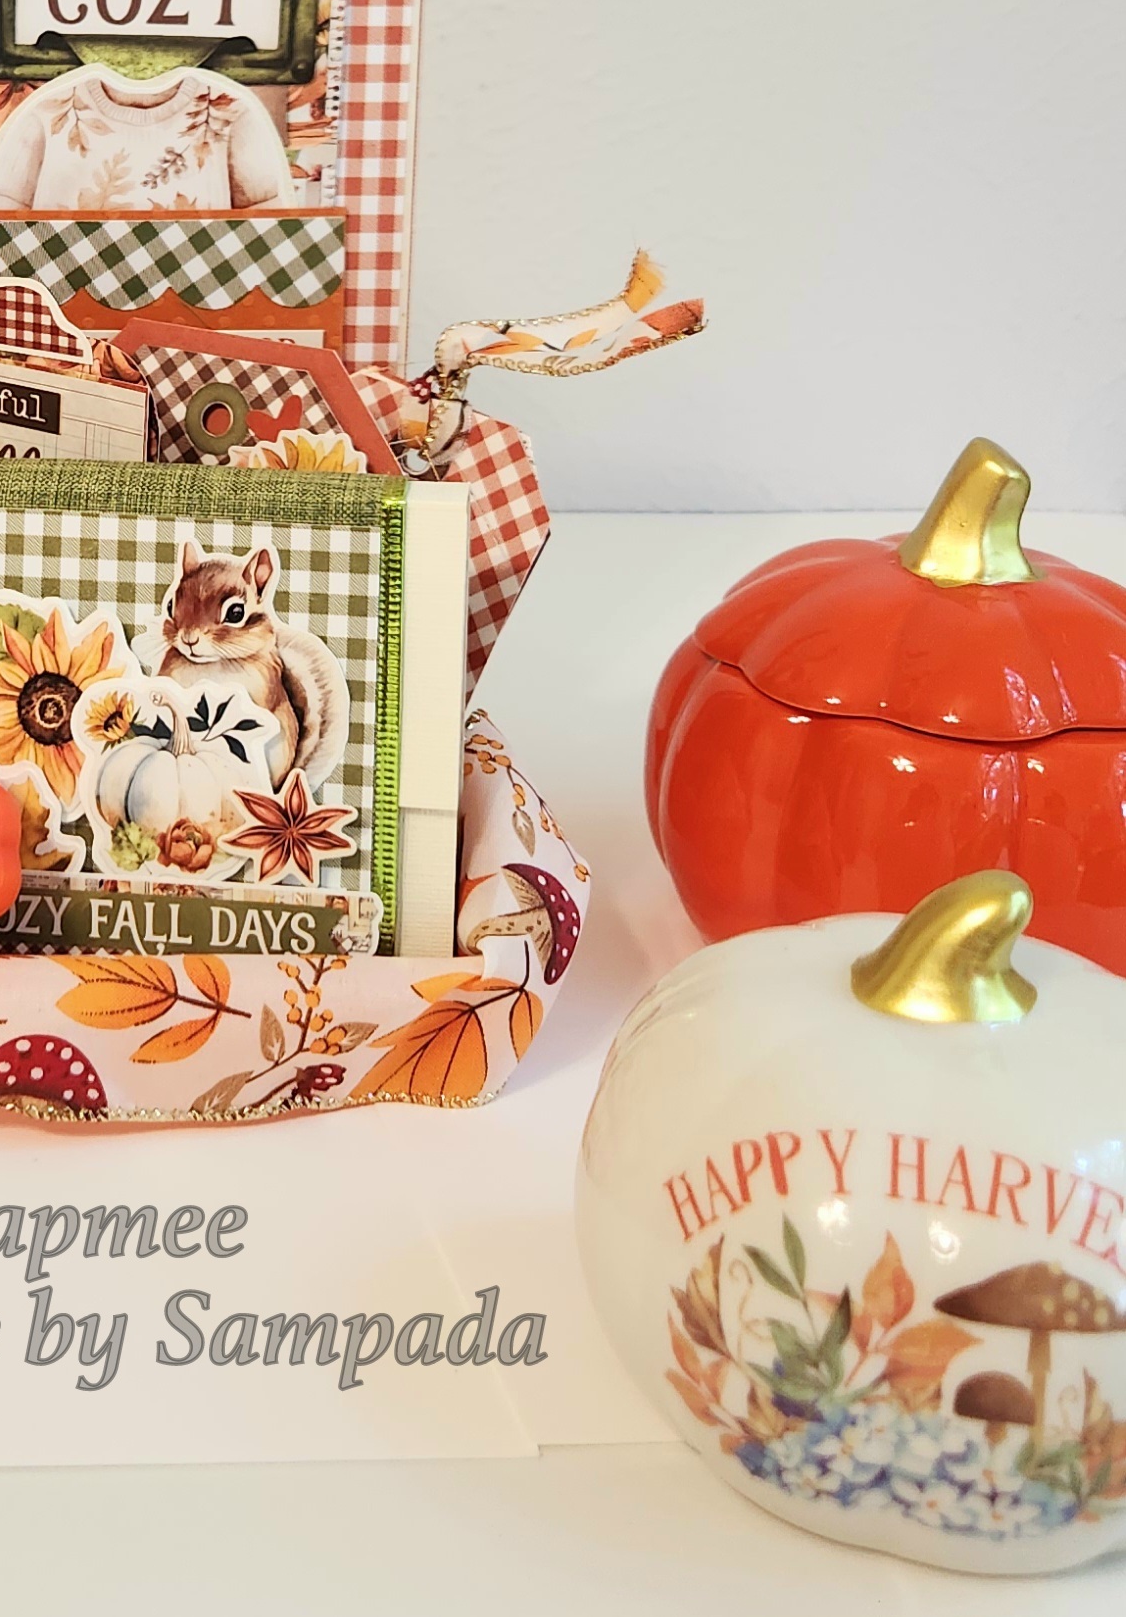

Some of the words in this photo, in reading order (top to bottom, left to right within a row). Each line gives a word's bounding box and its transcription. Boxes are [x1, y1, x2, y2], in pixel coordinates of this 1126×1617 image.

[88, 897, 193, 956] FALL
[209, 905, 316, 955] DAYS
[662, 1129, 858, 1242] HAPPY
[886, 1132, 1126, 1278] HARVE
